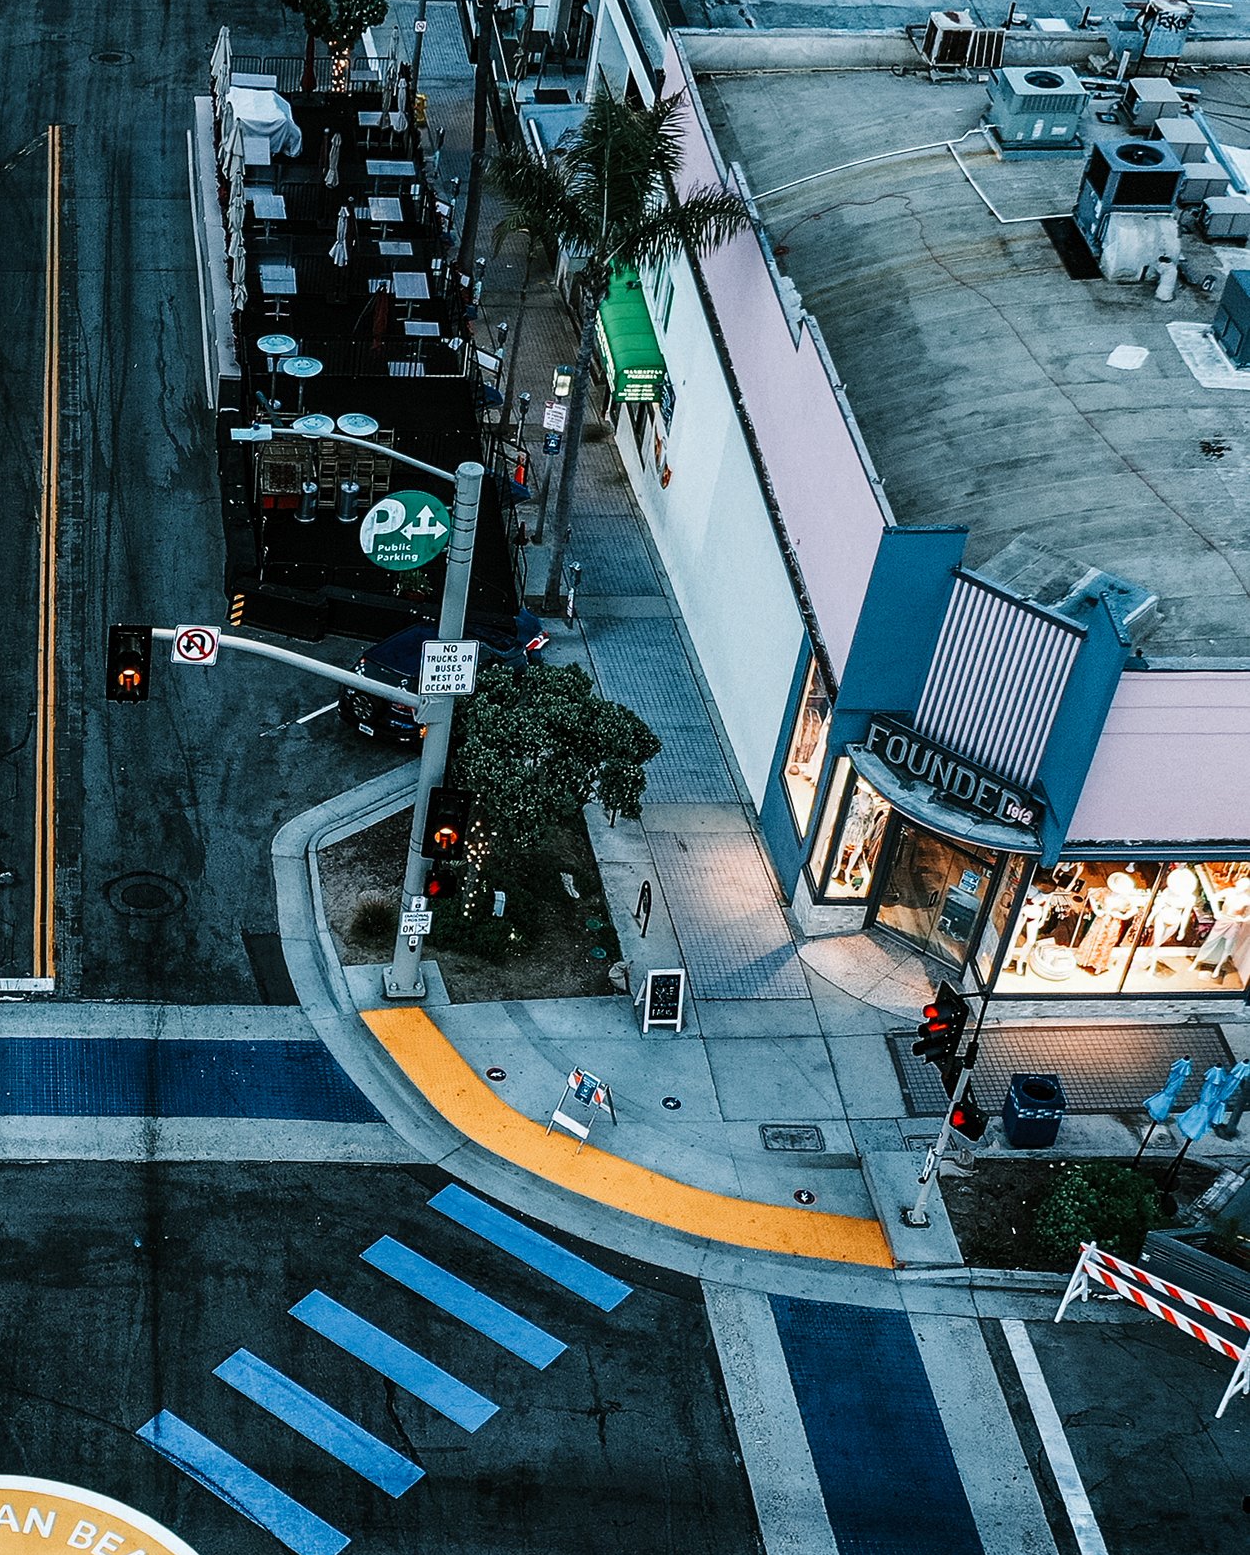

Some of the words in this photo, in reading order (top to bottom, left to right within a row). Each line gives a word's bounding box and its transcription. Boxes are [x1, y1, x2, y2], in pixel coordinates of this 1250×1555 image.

[359, 498, 406, 554] P
[377, 543, 411, 552] Public
[376, 552, 419, 562] Parking
[442, 644, 458, 653] NO
[426, 655, 458, 663] TRUCKS
[461, 654, 473, 662] OR
[434, 664, 462, 673] BUSES
[430, 674, 451, 682] WEST
[454, 674, 465, 682] OF
[424, 683, 452, 692] OCEAN
[865, 723, 1023, 823] FOUNDED
[402, 925, 415, 933] OK
